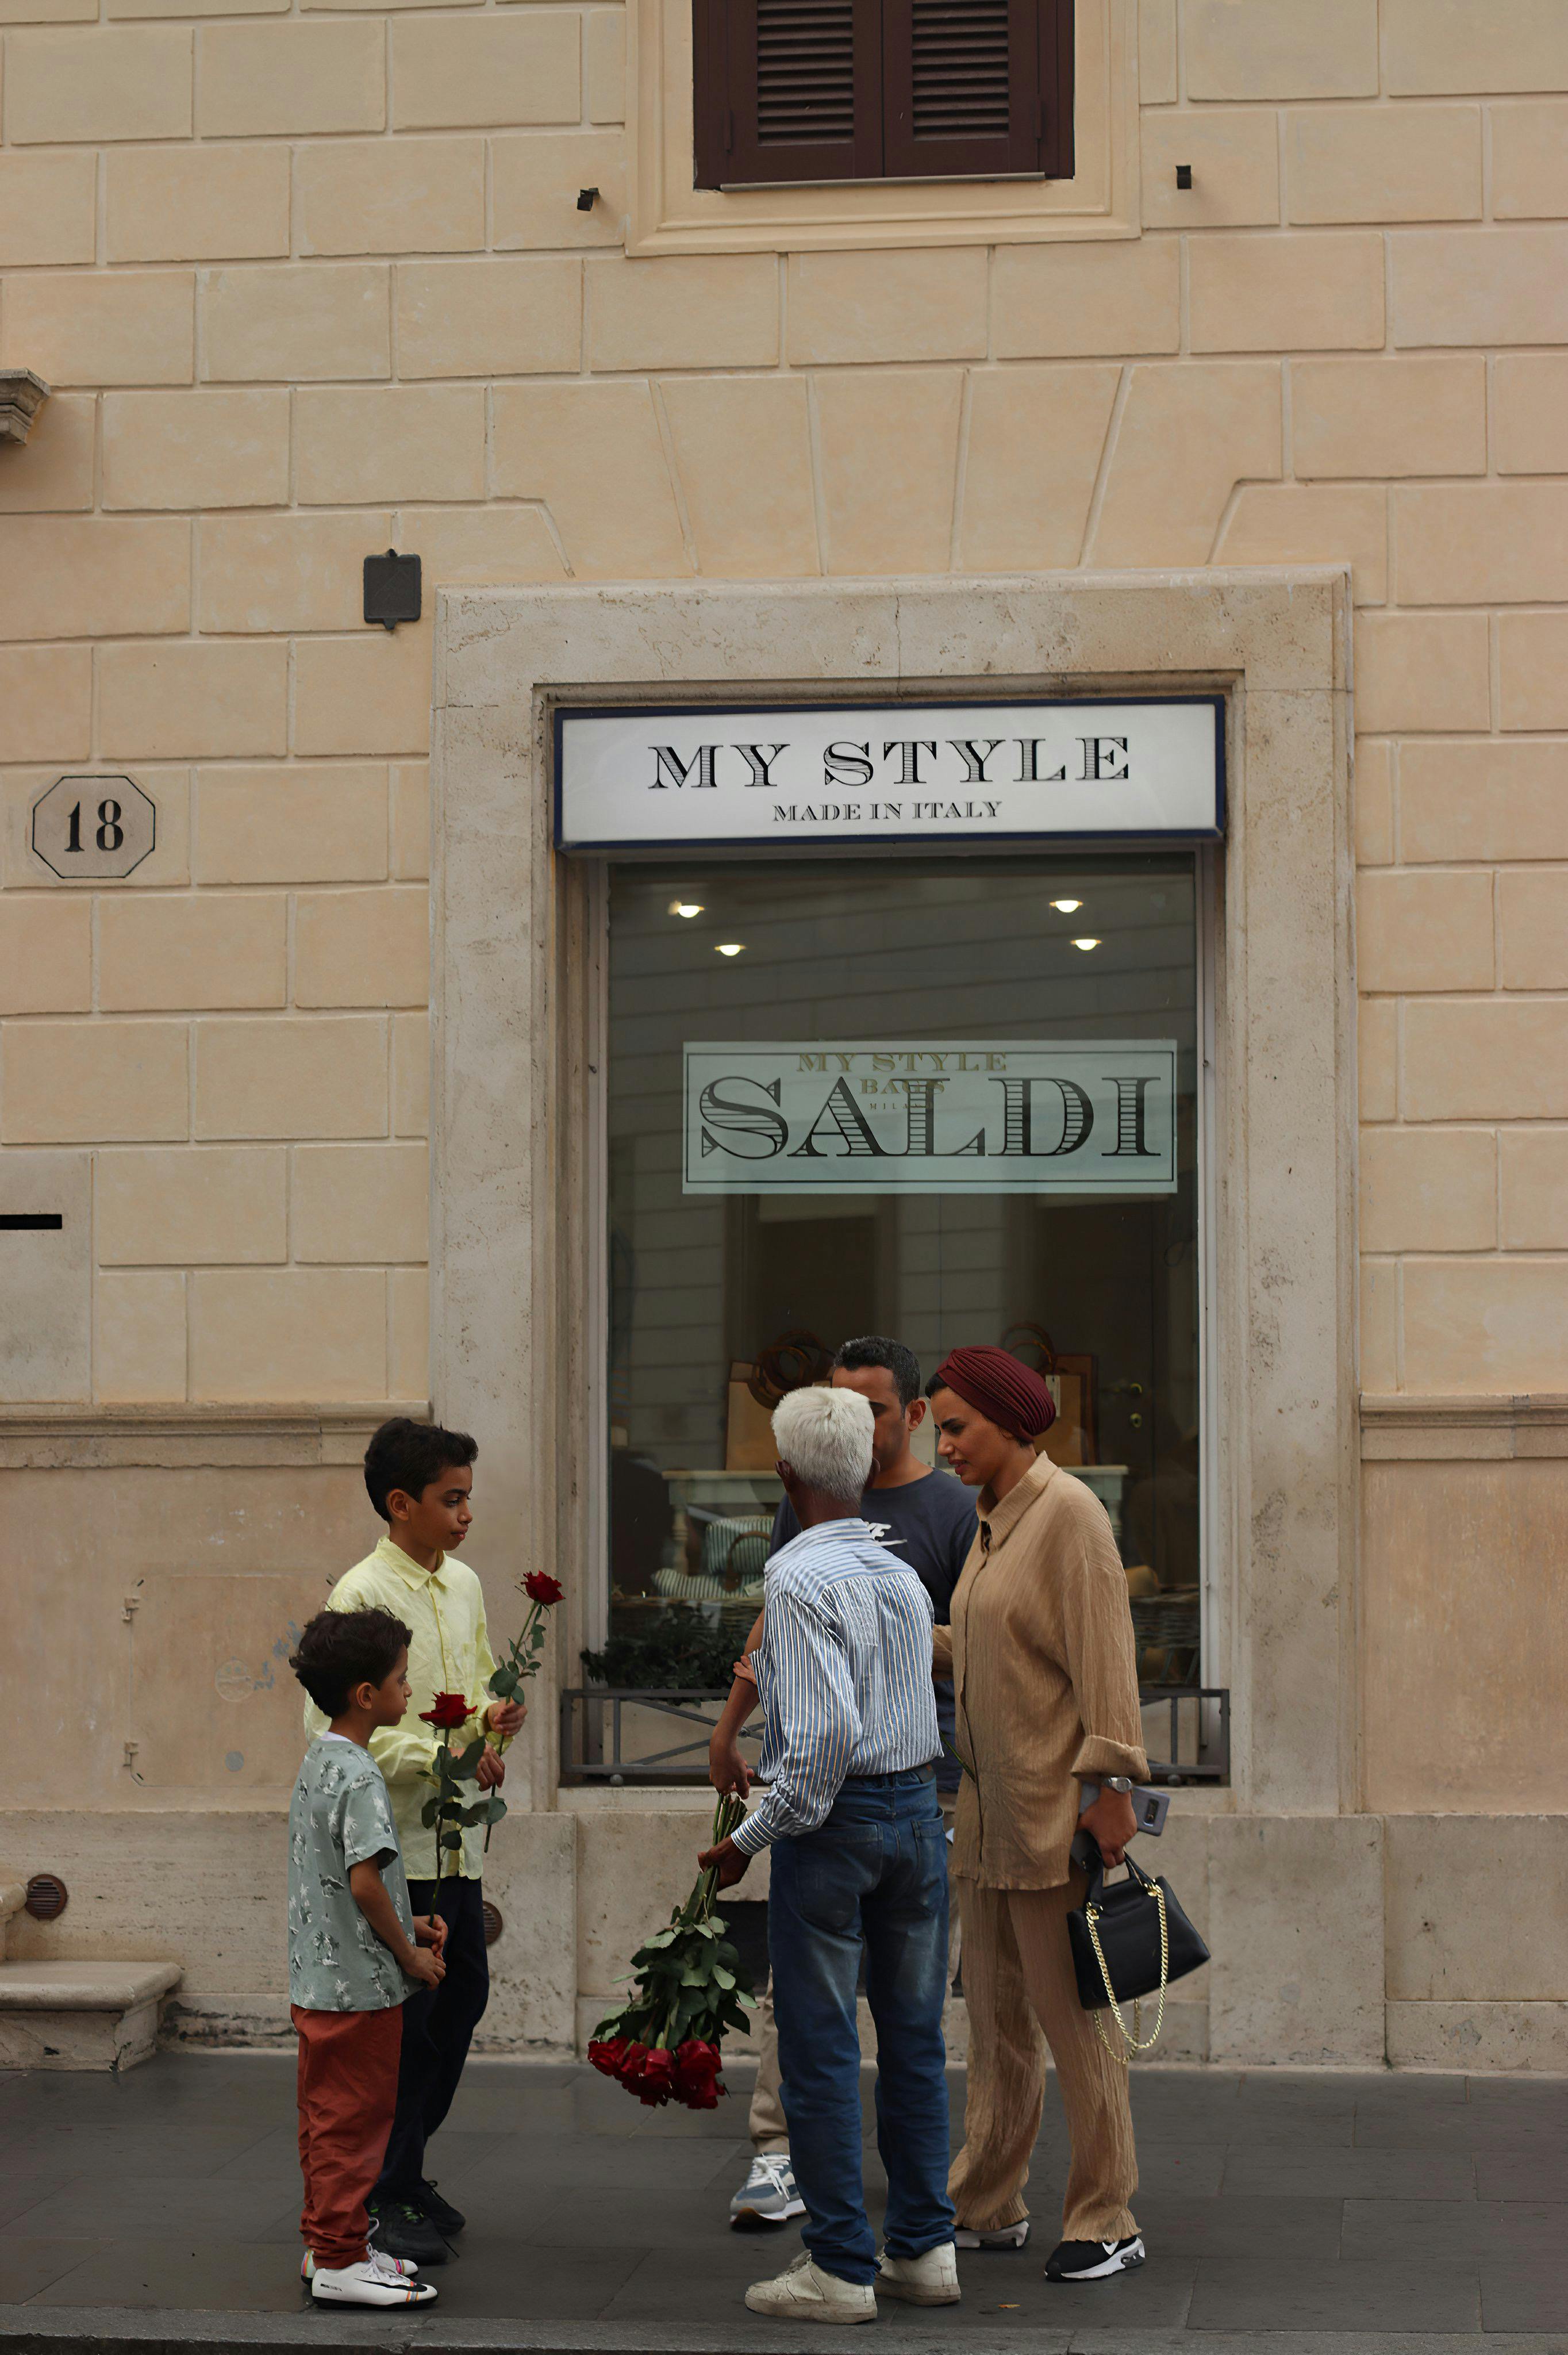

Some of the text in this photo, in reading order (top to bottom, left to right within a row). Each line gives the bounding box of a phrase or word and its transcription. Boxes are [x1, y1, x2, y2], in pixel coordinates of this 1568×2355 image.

[648, 737, 1129, 789] MY STYLE
[64, 799, 124, 852] 18
[772, 801, 1003, 822] MADE IN ITALY
[797, 1052, 1007, 1072] MY STYLE
[699, 1075, 1162, 1160] SALDI
